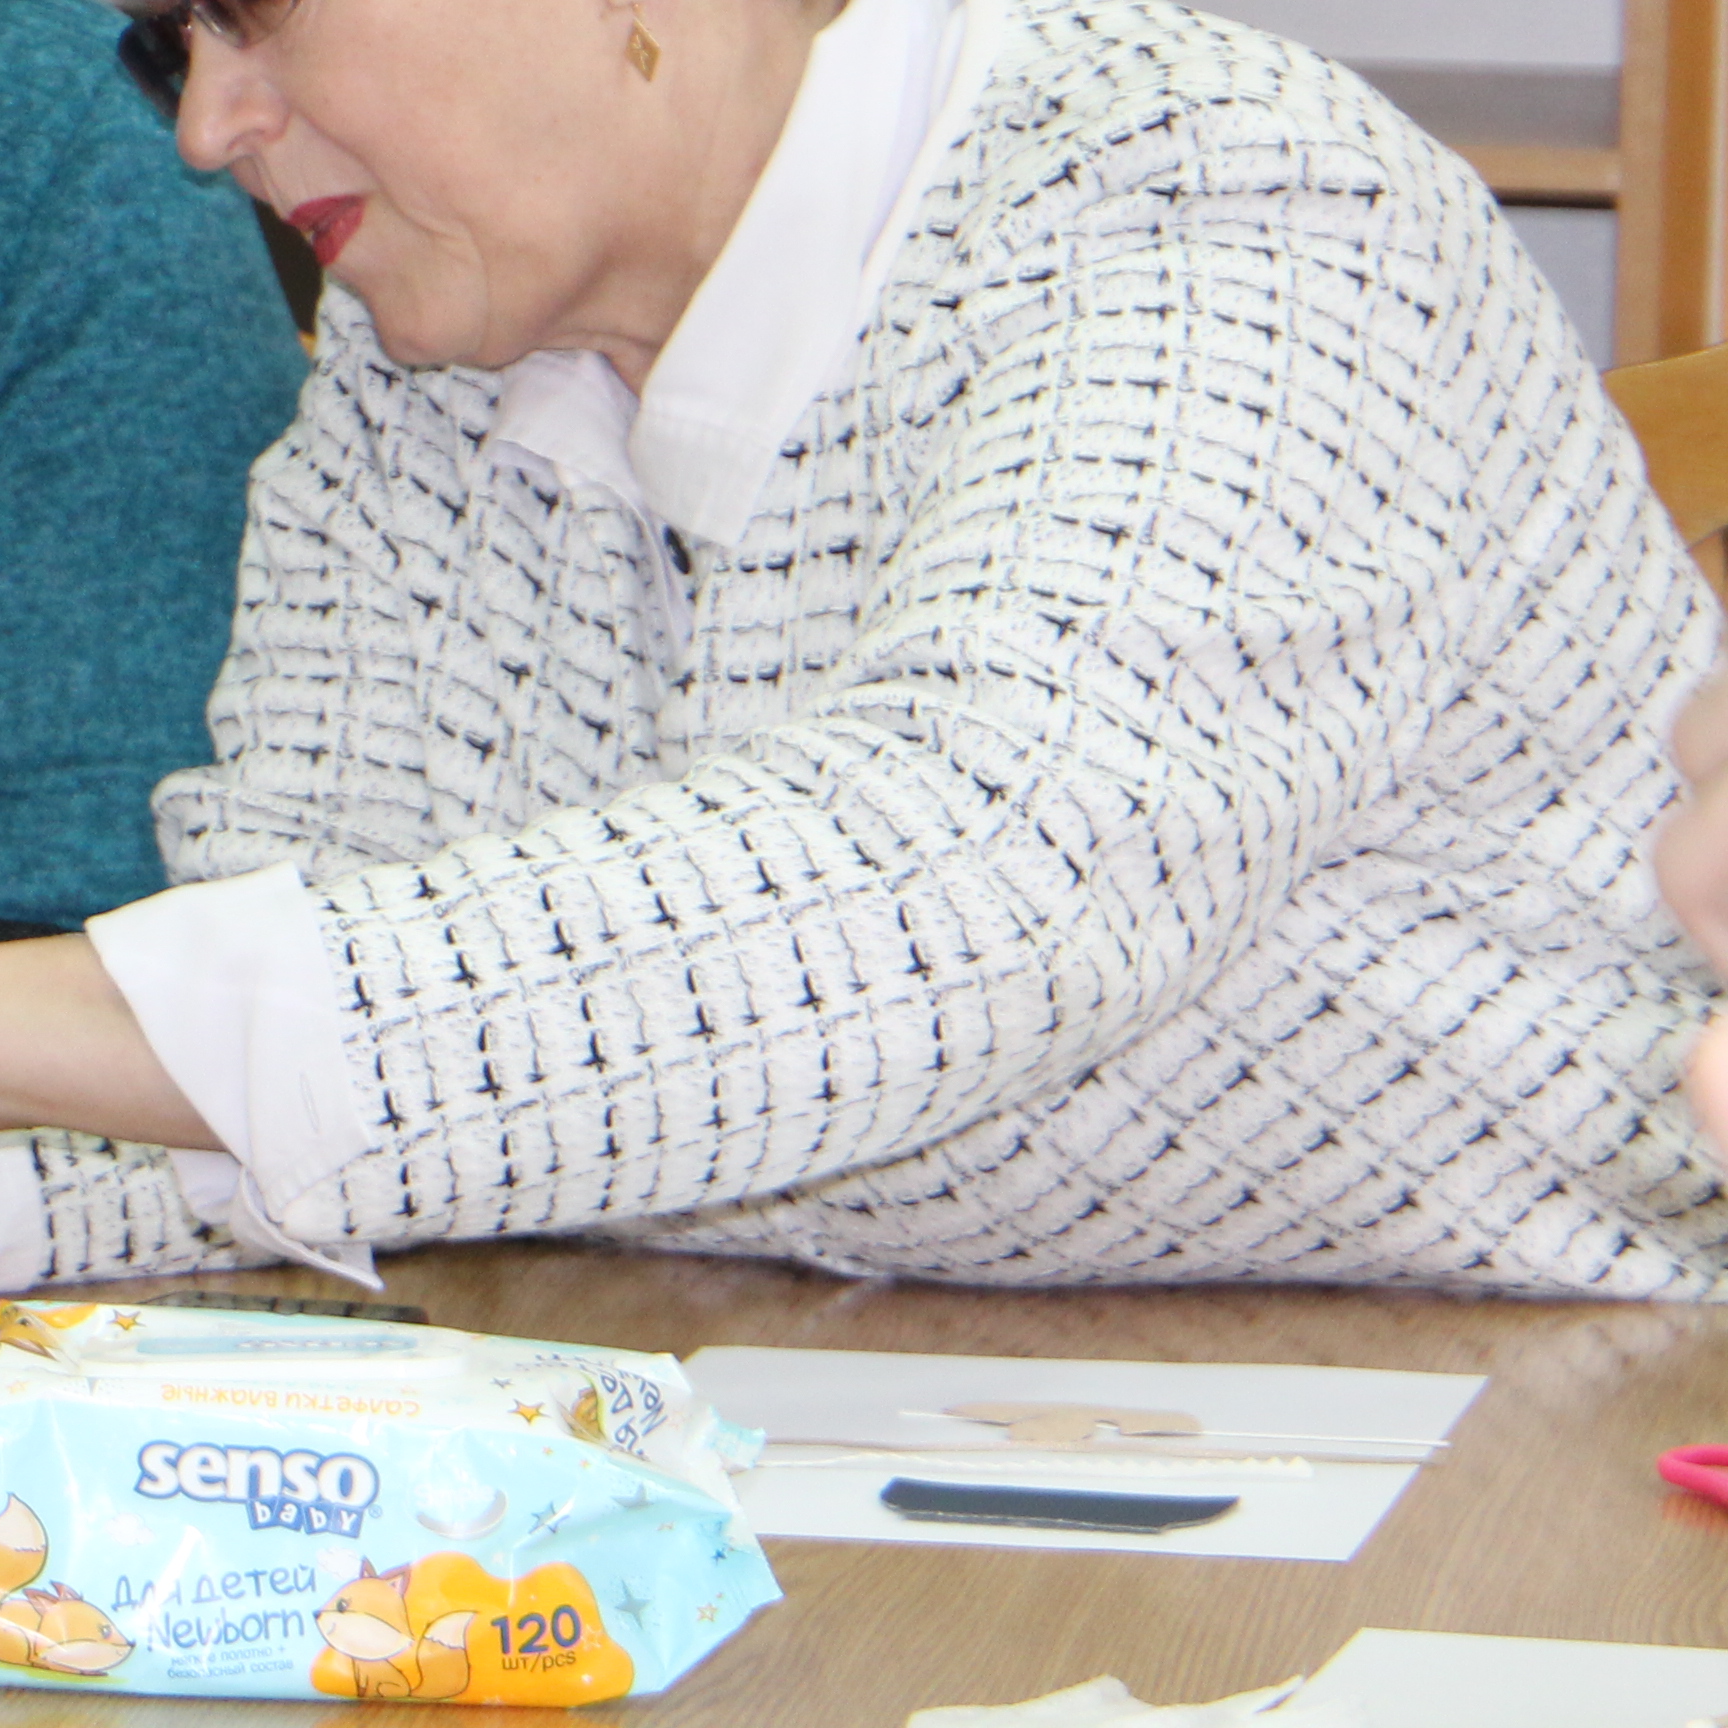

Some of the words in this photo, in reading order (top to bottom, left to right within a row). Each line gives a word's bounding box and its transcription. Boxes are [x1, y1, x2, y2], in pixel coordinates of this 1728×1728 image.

[135, 1440, 380, 1505] senso
[146, 1607, 306, 1653] Newborn
[490, 1604, 581, 1654] 120
[502, 1651, 576, 1672] шт/pcs
